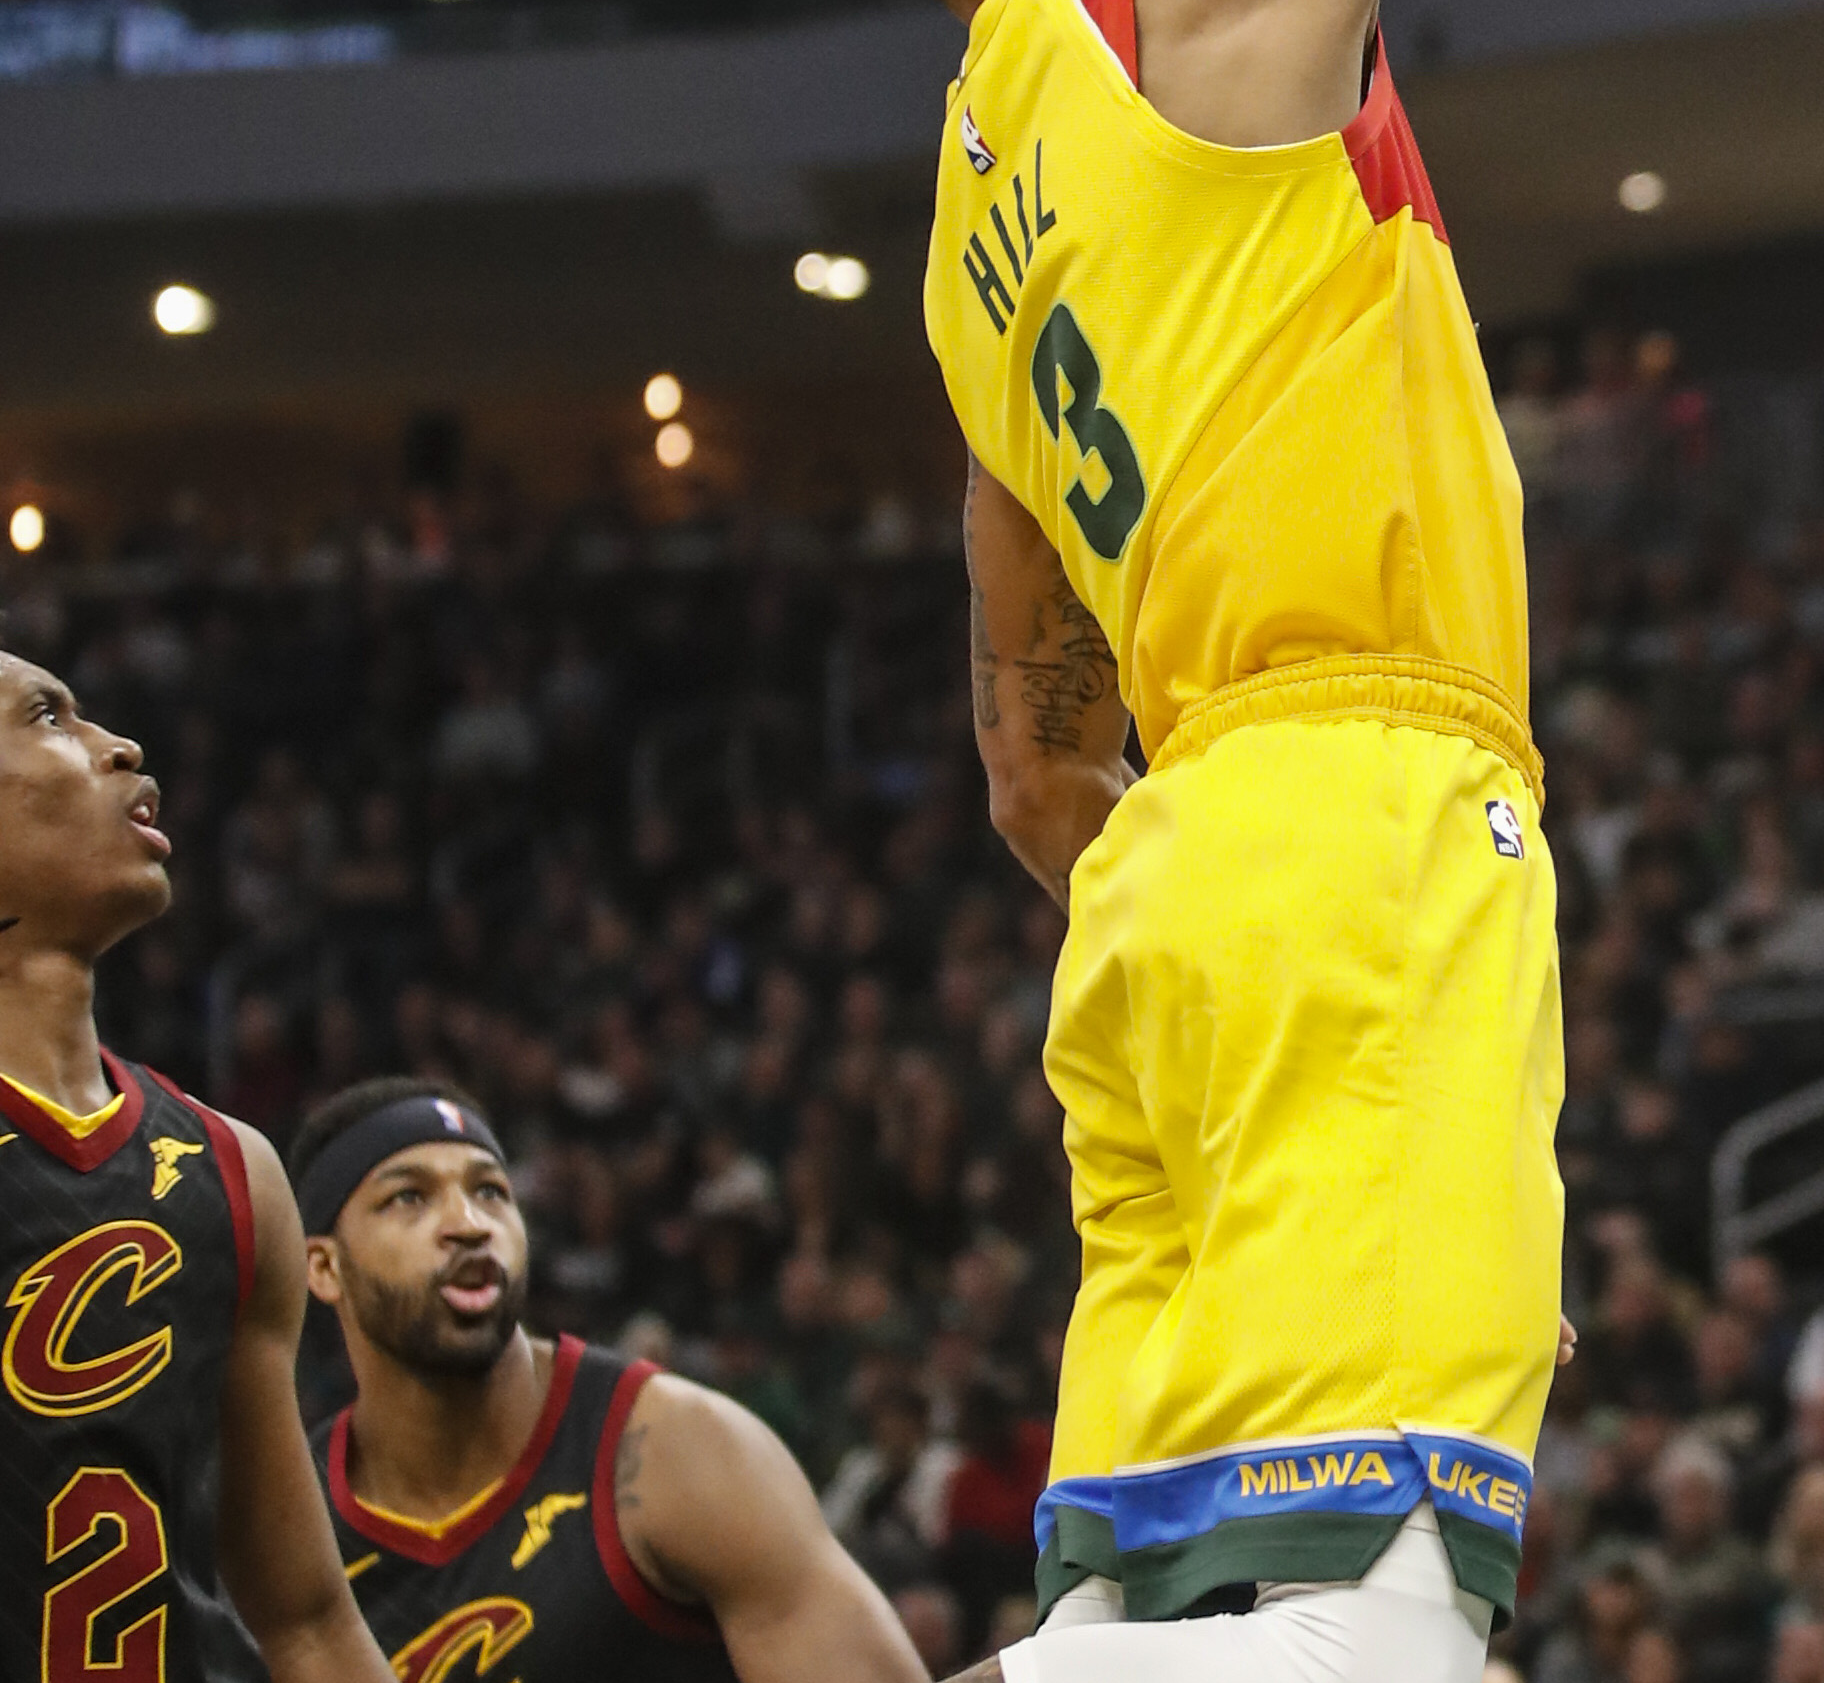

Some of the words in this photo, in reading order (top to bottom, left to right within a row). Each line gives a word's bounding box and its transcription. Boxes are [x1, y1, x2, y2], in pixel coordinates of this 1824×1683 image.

[963, 138, 1056, 336] HILL
[1031, 302, 1148, 563] 3
[2, 1219, 183, 1419] C
